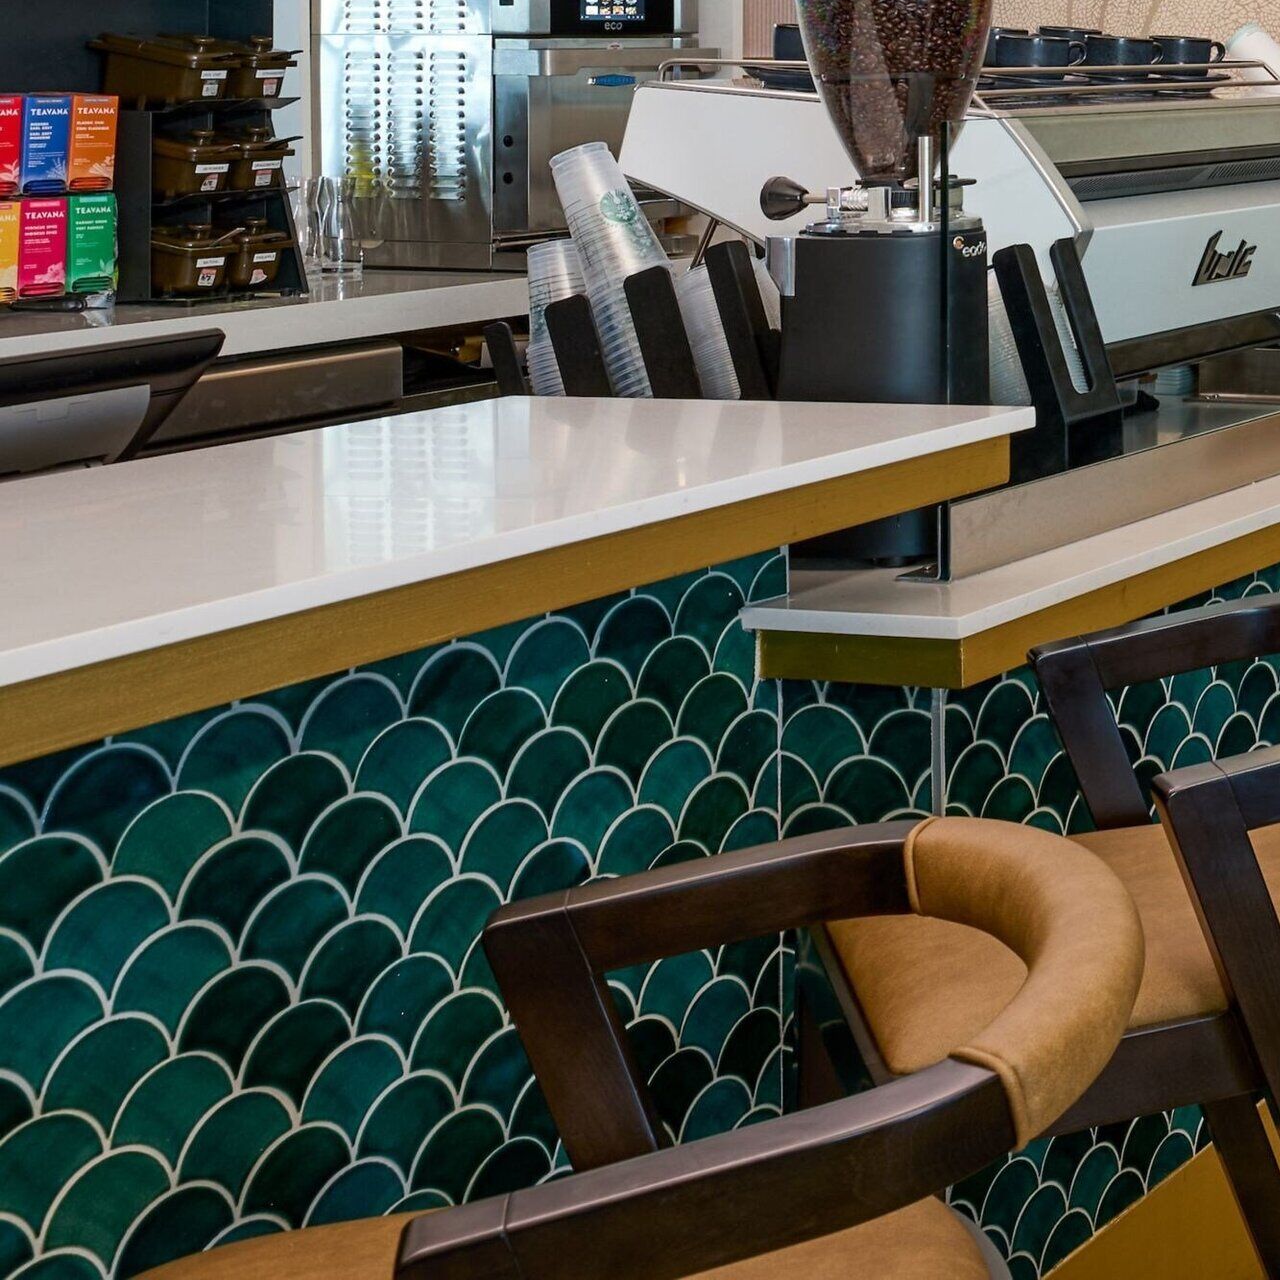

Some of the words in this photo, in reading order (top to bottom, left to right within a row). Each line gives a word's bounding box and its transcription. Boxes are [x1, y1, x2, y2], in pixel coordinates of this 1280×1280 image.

[604, 21, 623, 31] eco
[31, 108, 69, 116] TEAVANA
[77, 107, 115, 115] TEAVANA
[25, 210, 65, 220] TEAVANA
[75, 206, 111, 215] TEAVANA
